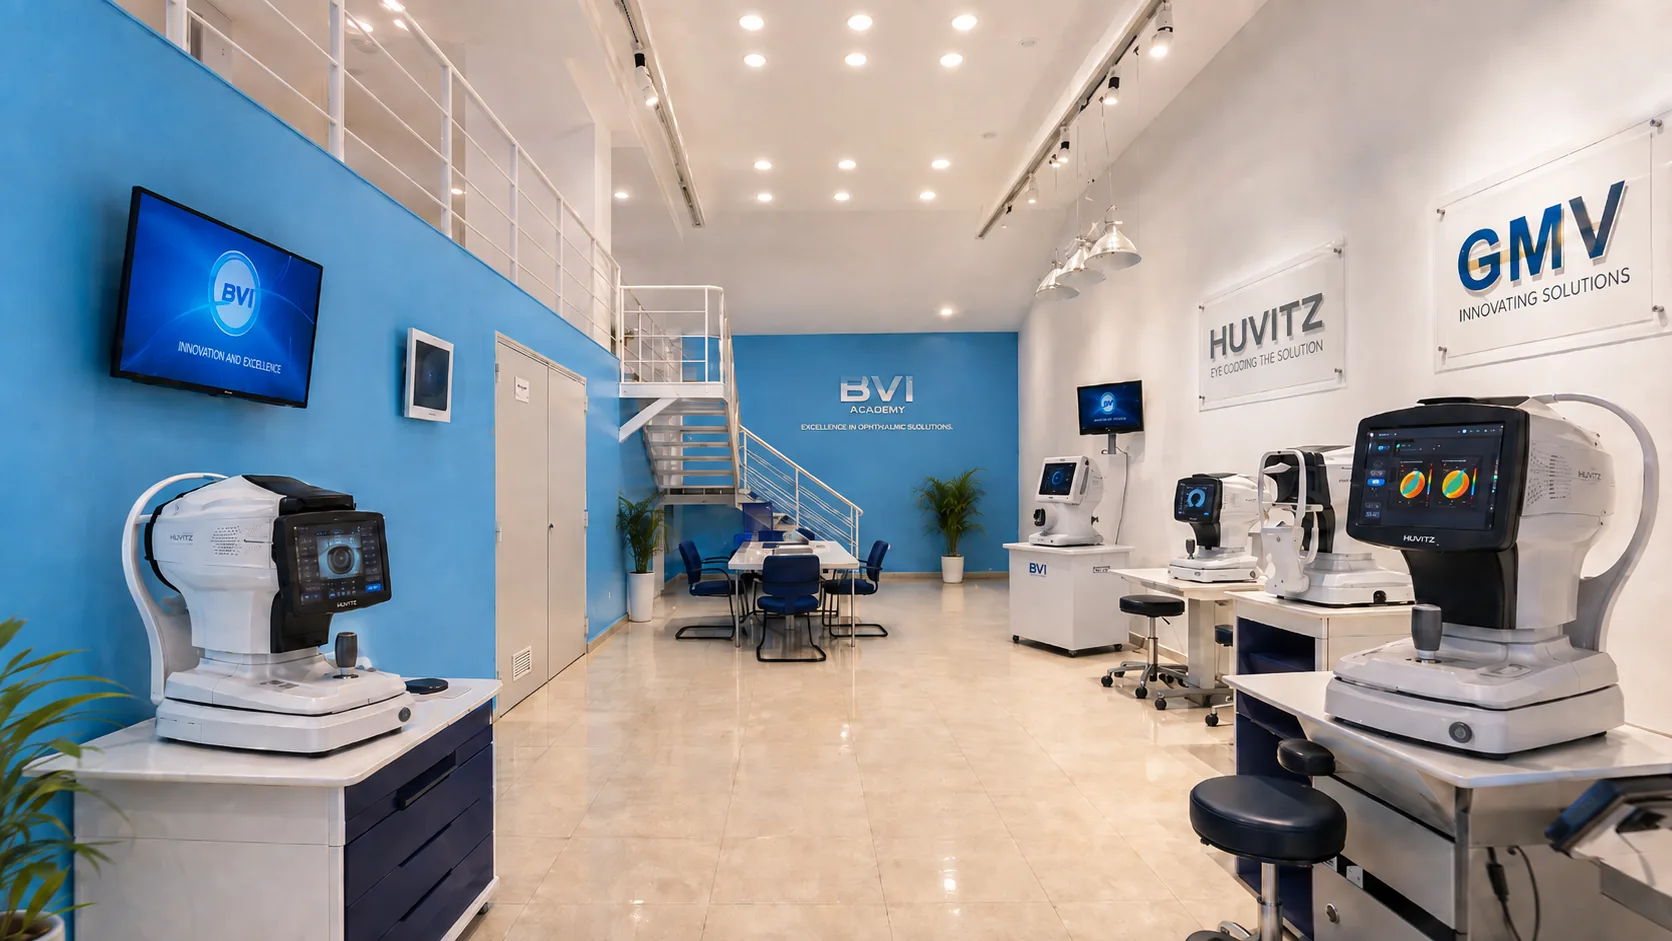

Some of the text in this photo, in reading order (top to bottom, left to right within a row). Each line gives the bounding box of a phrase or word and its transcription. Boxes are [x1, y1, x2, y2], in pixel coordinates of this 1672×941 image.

[1457, 180, 1626, 291] GMV
[222, 282, 256, 309] BVI
[1459, 267, 1631, 323] INNOVATING SOLUTIONS
[1210, 292, 1323, 360] HUVITZ
[178, 341, 225, 361] INNOVATION
[225, 353, 241, 365] AND
[1210, 365, 1222, 378] EYE
[1259, 351, 1275, 366] THE
[1277, 339, 1323, 362] SOLUTION
[840, 375, 913, 402] BVI
[850, 405, 906, 414] ACADEMY
[801, 423, 847, 431] EXCELLENCE
[848, 423, 857, 431] IN
[1403, 535, 1435, 544] HUVITZ
[1029, 562, 1047, 575] BVI
